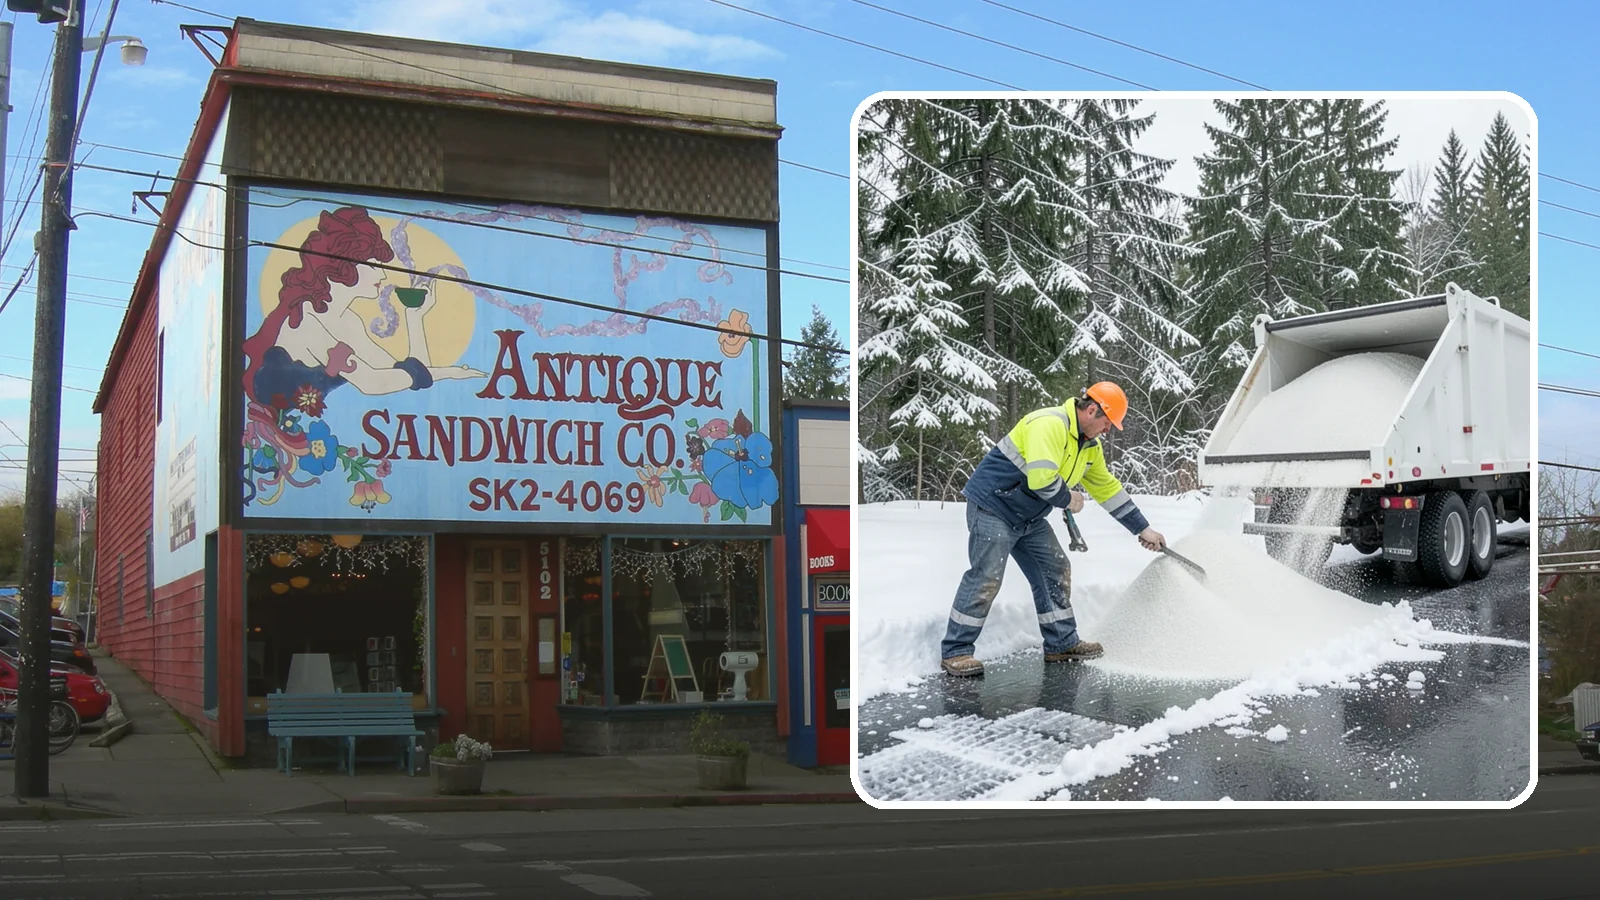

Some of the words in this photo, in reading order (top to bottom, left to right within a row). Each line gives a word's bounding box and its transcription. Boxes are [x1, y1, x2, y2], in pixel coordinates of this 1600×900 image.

[476, 329, 723, 421] ANTIQUE
[361, 409, 604, 468] SANDWICH
[617, 423, 685, 470] CO.
[469, 477, 646, 513] SK2-4069
[539, 541, 552, 600] 5102
[809, 554, 835, 569] BOOKS
